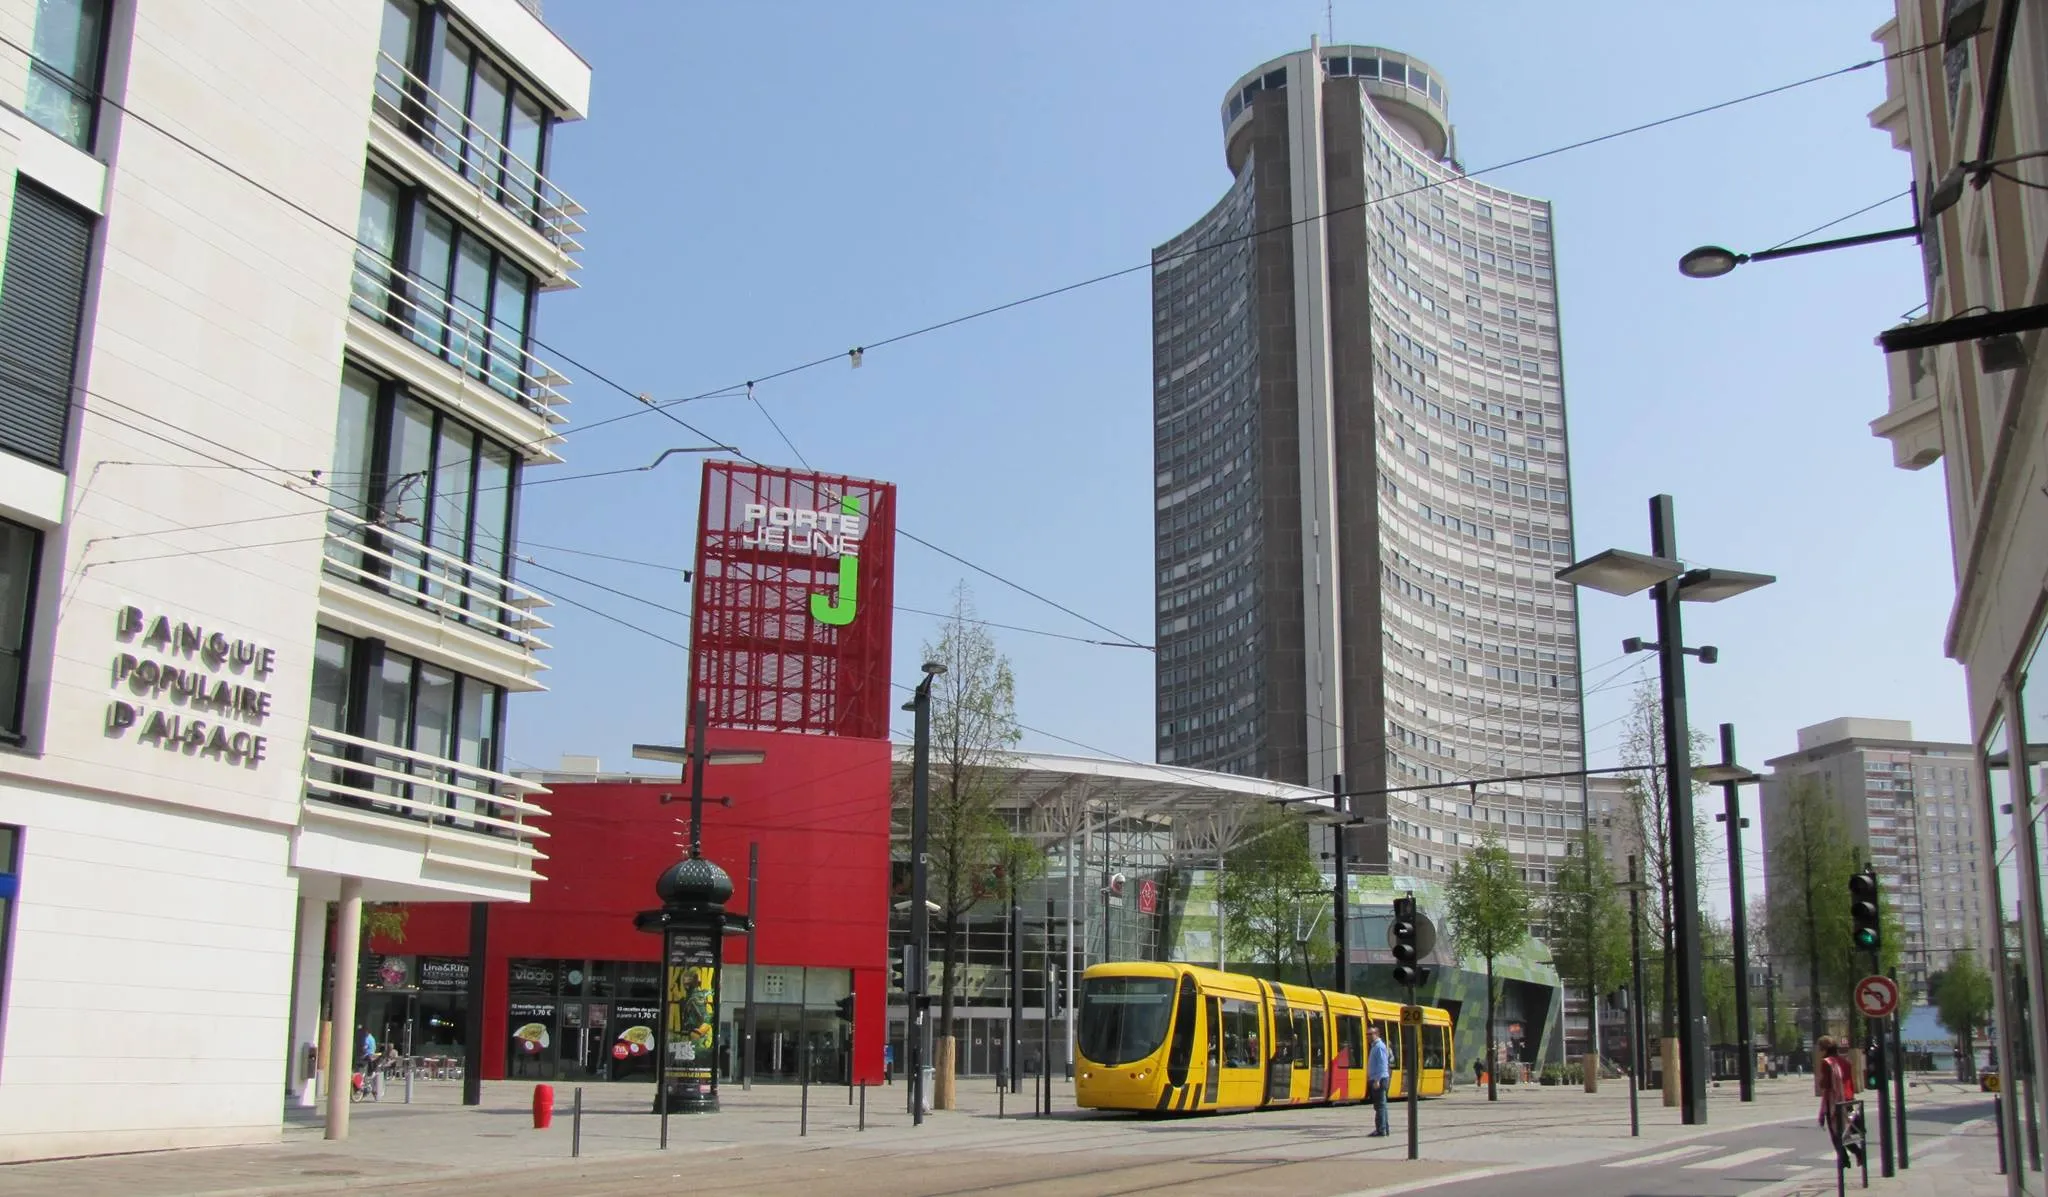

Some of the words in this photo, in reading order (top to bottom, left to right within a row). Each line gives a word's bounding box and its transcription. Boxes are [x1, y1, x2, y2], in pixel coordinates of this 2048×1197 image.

[744, 503, 860, 535] PORTE
[743, 525, 860, 556] JEUNE
[116, 605, 276, 677] BANQUE
[112, 652, 272, 721] POPULAIRE
[105, 700, 267, 765] D'ALSACE
[423, 963, 469, 973] Lina&Rita
[533, 1009, 545, 1017] 1,70
[638, 1012, 651, 1020] 1,70
[1403, 1010, 1421, 1021] 20
